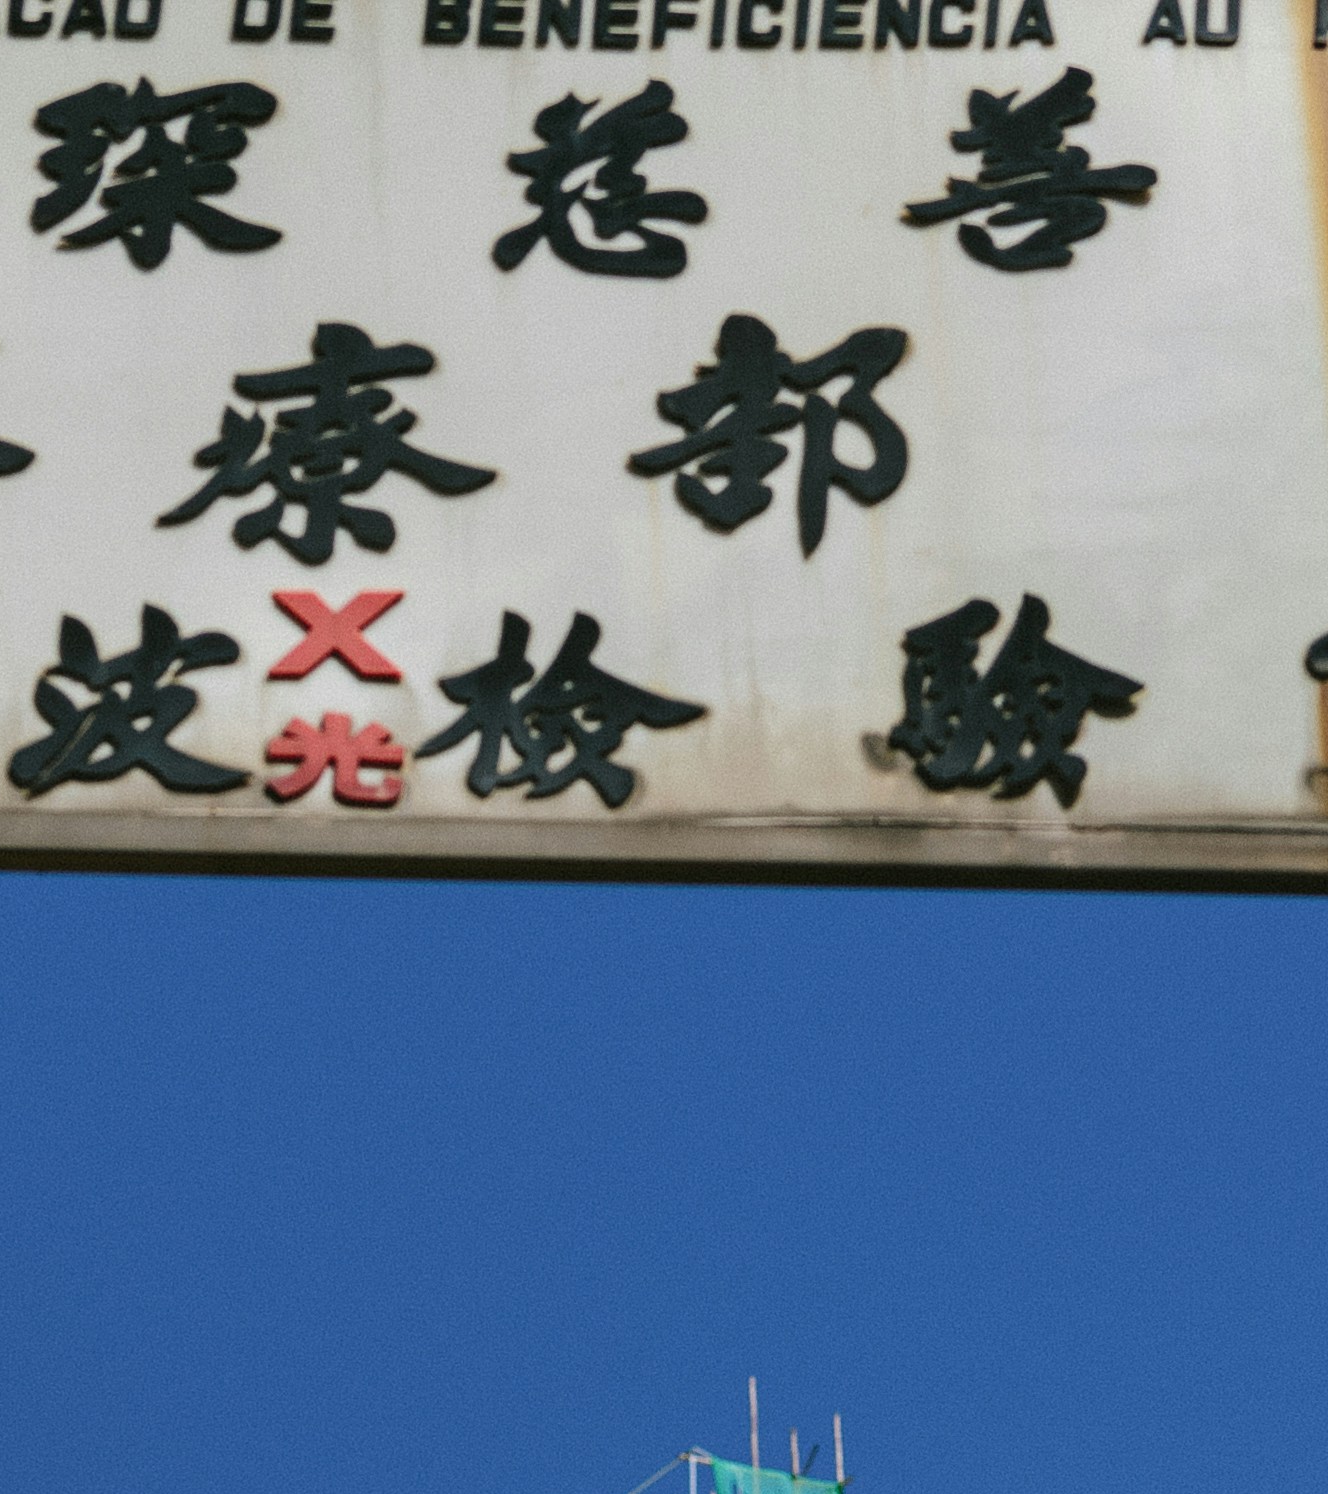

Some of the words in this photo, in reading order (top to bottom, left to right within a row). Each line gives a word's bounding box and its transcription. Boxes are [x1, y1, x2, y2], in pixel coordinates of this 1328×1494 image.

[231, 0, 336, 43] DE
[420, 0, 1056, 51] BENEFICIENCIA
[1142, 0, 1240, 50] AU
